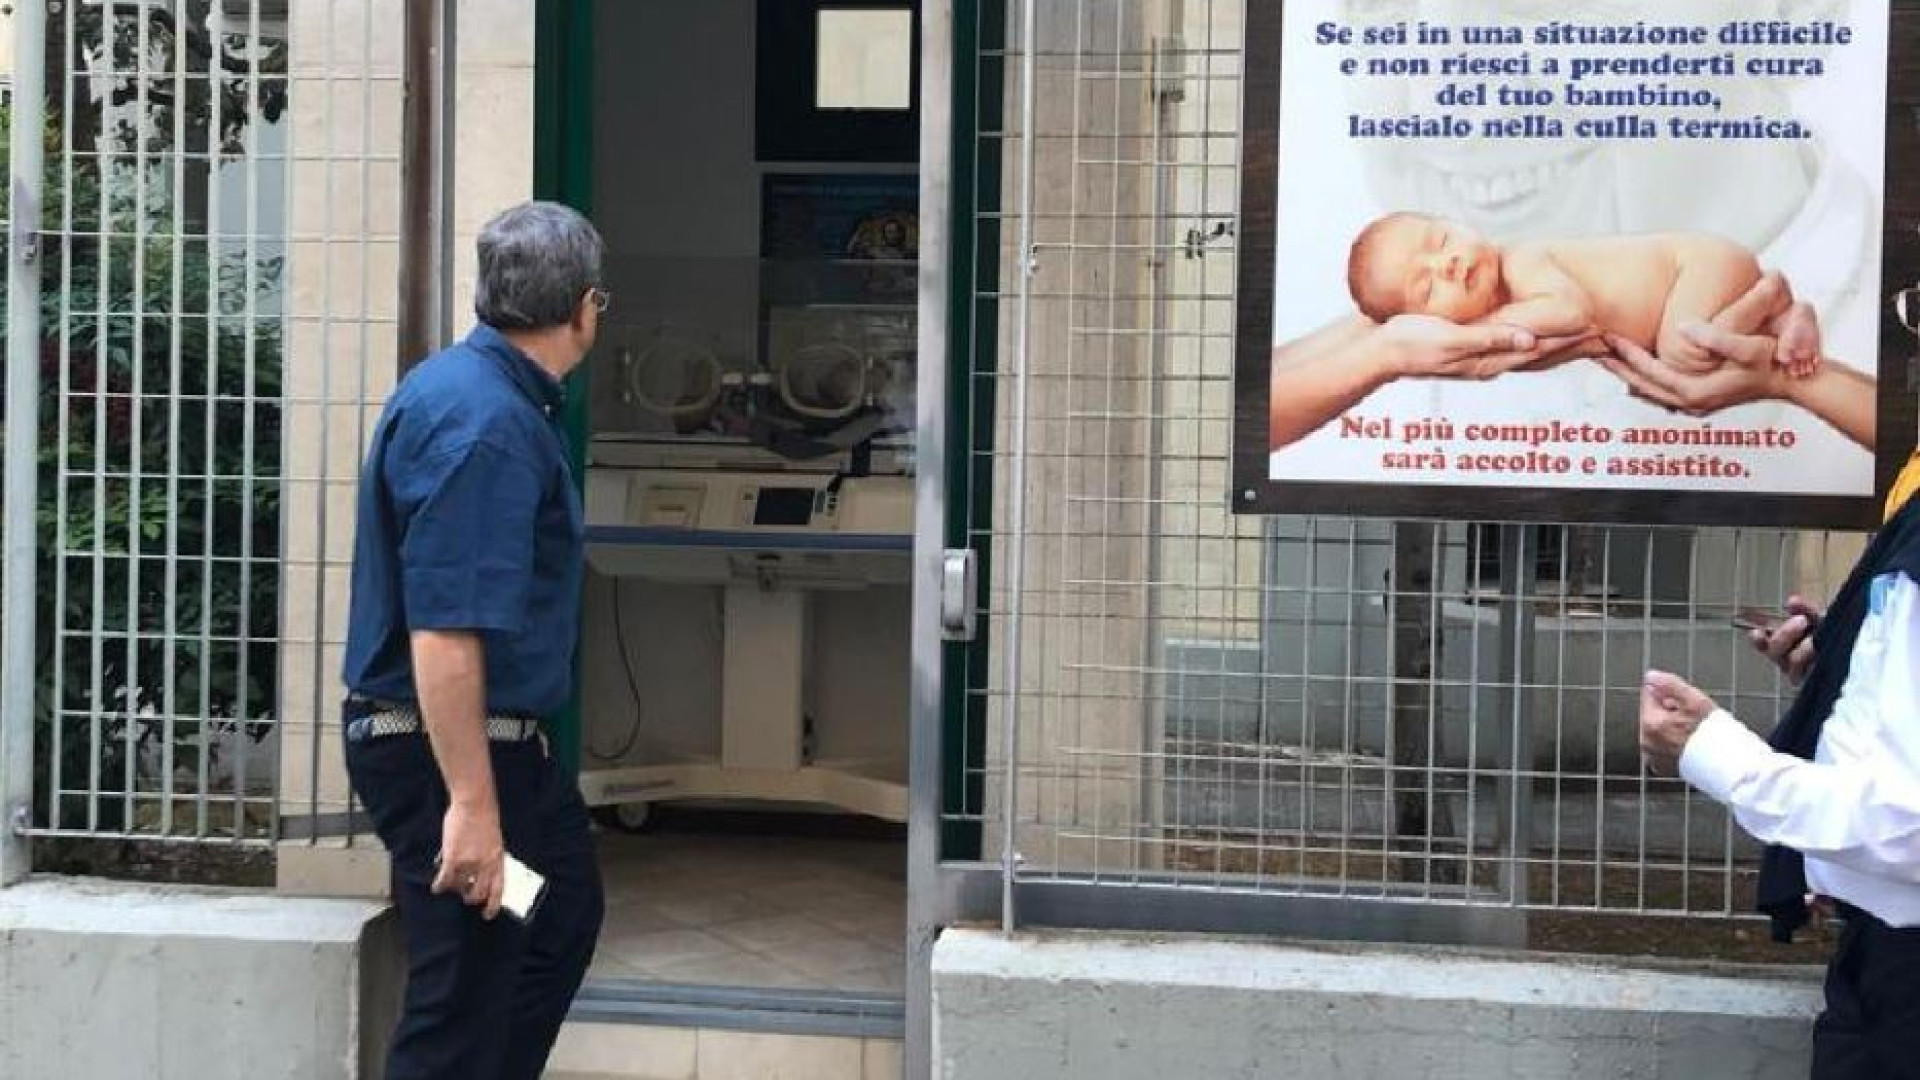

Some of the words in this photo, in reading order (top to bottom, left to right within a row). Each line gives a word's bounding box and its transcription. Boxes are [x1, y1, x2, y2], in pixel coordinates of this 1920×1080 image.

[1316, 22, 1353, 46] Se
[1363, 22, 1407, 46] sei
[1417, 22, 1451, 45] in
[1462, 26, 1524, 45] una
[1534, 21, 1709, 45] situazione
[1717, 21, 1853, 46] difficile
[1339, 59, 1358, 75] e
[1368, 58, 1429, 75] non
[1441, 52, 1530, 77] riesci
[1540, 58, 1559, 75] a
[1569, 52, 1735, 81] prenderti
[1746, 57, 1824, 76] cura
[1435, 83, 1487, 106] del
[1497, 84, 1555, 106] tuo
[1565, 83, 1722, 112] bambino,
[1349, 114, 1473, 138] lascialo
[1482, 114, 1563, 139] nella
[1573, 114, 1657, 139] culla
[1668, 114, 1812, 139] termica.
[1339, 415, 1391, 438] Nel
[1403, 417, 1454, 445] più
[1464, 419, 1611, 446] completo
[1622, 423, 1796, 447] anonimato
[1382, 447, 1446, 470] sarà
[1456, 450, 1571, 474] accolto
[1581, 456, 1598, 474] e
[1606, 453, 1751, 479] assistito.
